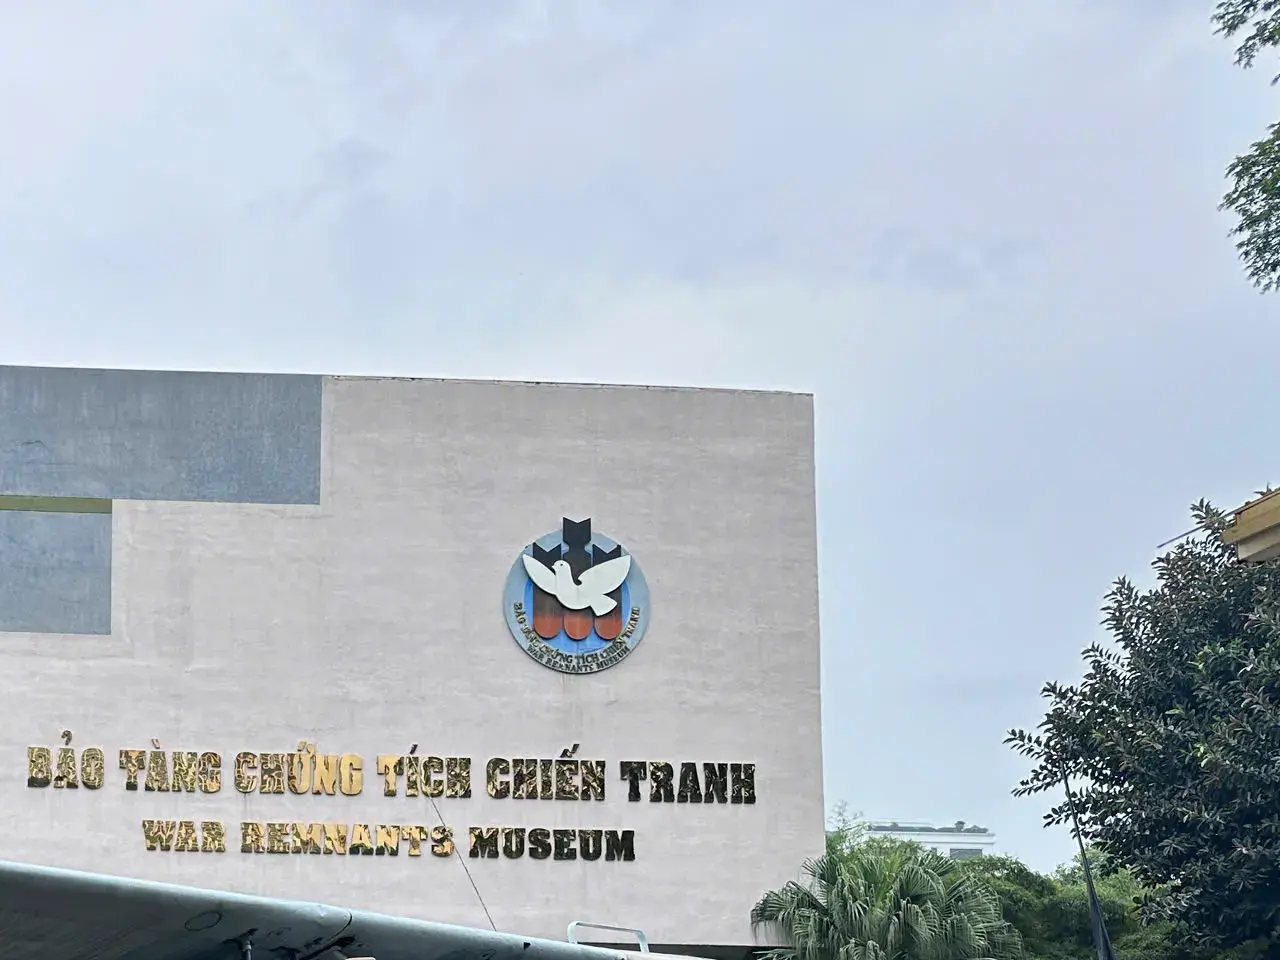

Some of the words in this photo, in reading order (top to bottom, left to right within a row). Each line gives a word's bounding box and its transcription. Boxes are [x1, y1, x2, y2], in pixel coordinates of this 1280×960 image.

[27, 730, 104, 789] BẢO
[120, 738, 221, 793] TÀNG
[233, 740, 363, 795] CHỨNG
[376, 744, 472, 799] TÍCH
[486, 743, 606, 801] CHIẾN
[620, 760, 757, 804] TRANH
[142, 820, 225, 852] WAR
[241, 822, 455, 857] REMNANTS
[469, 827, 636, 862] MUSEUM
